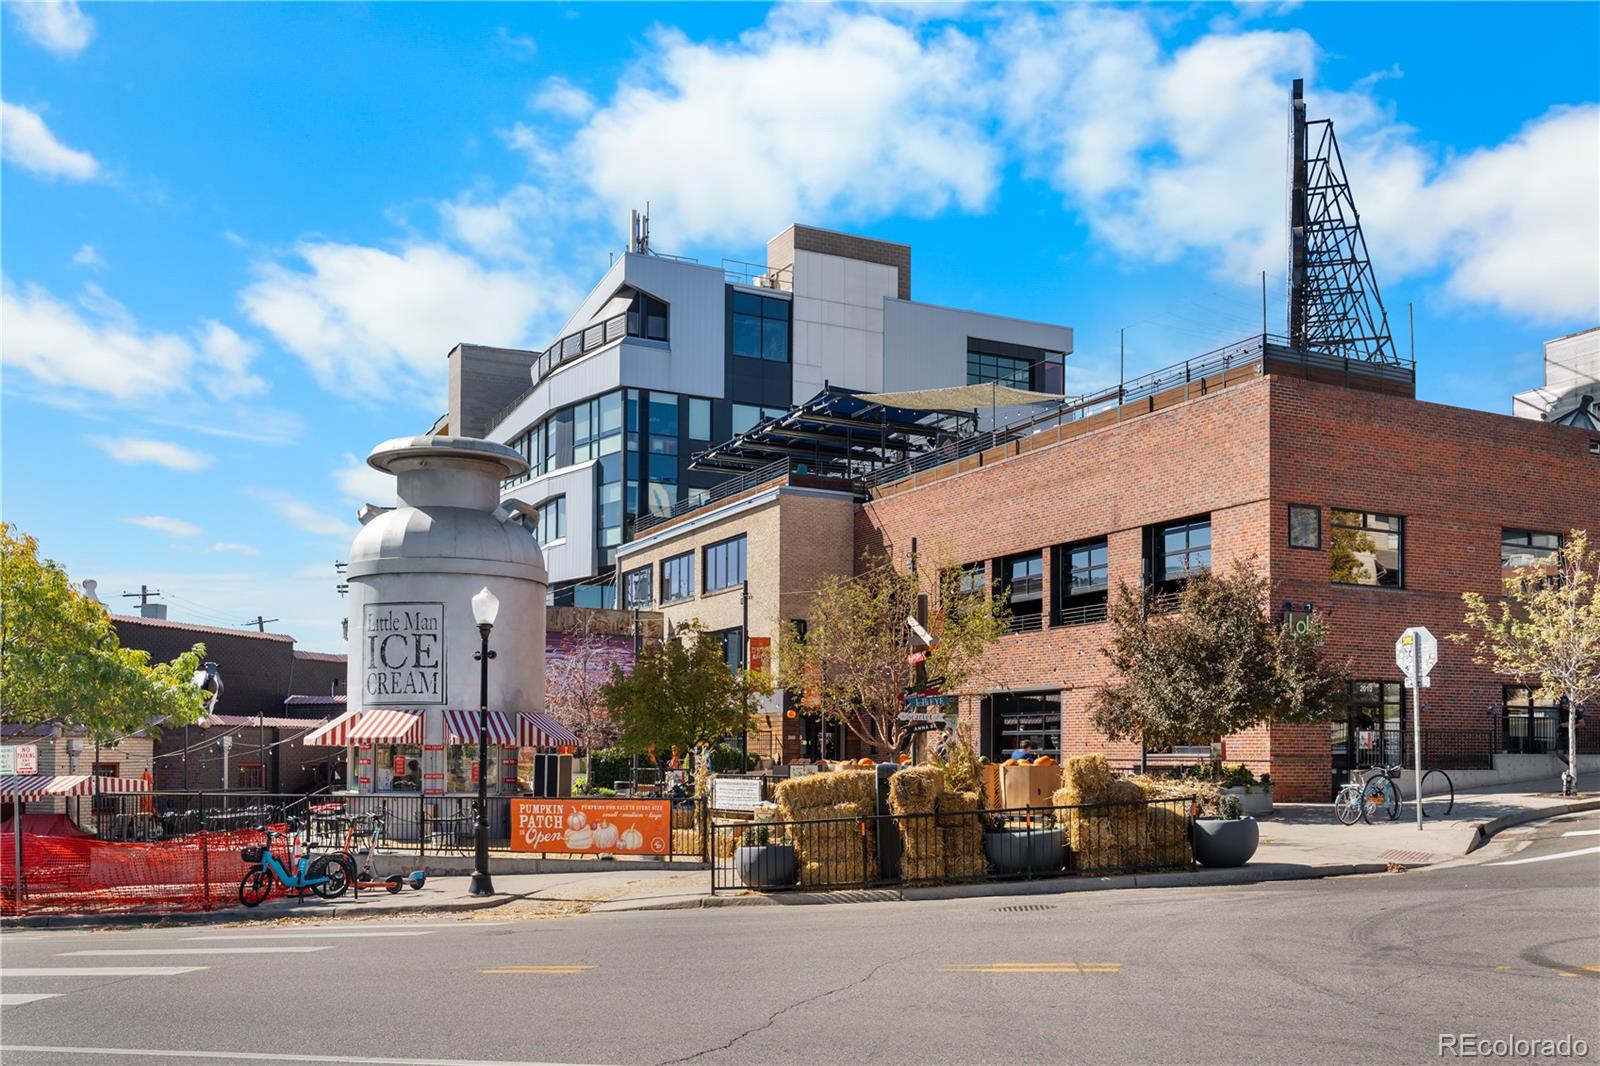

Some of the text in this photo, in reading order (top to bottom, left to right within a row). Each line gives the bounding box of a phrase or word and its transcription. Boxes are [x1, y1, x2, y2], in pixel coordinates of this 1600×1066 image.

[367, 610, 438, 632] Little Man
[367, 633, 439, 670] ICE
[367, 671, 439, 695] CREAM
[519, 803, 564, 815] PUMPKIN
[519, 814, 564, 829] PATCH
[525, 827, 565, 849] Open
